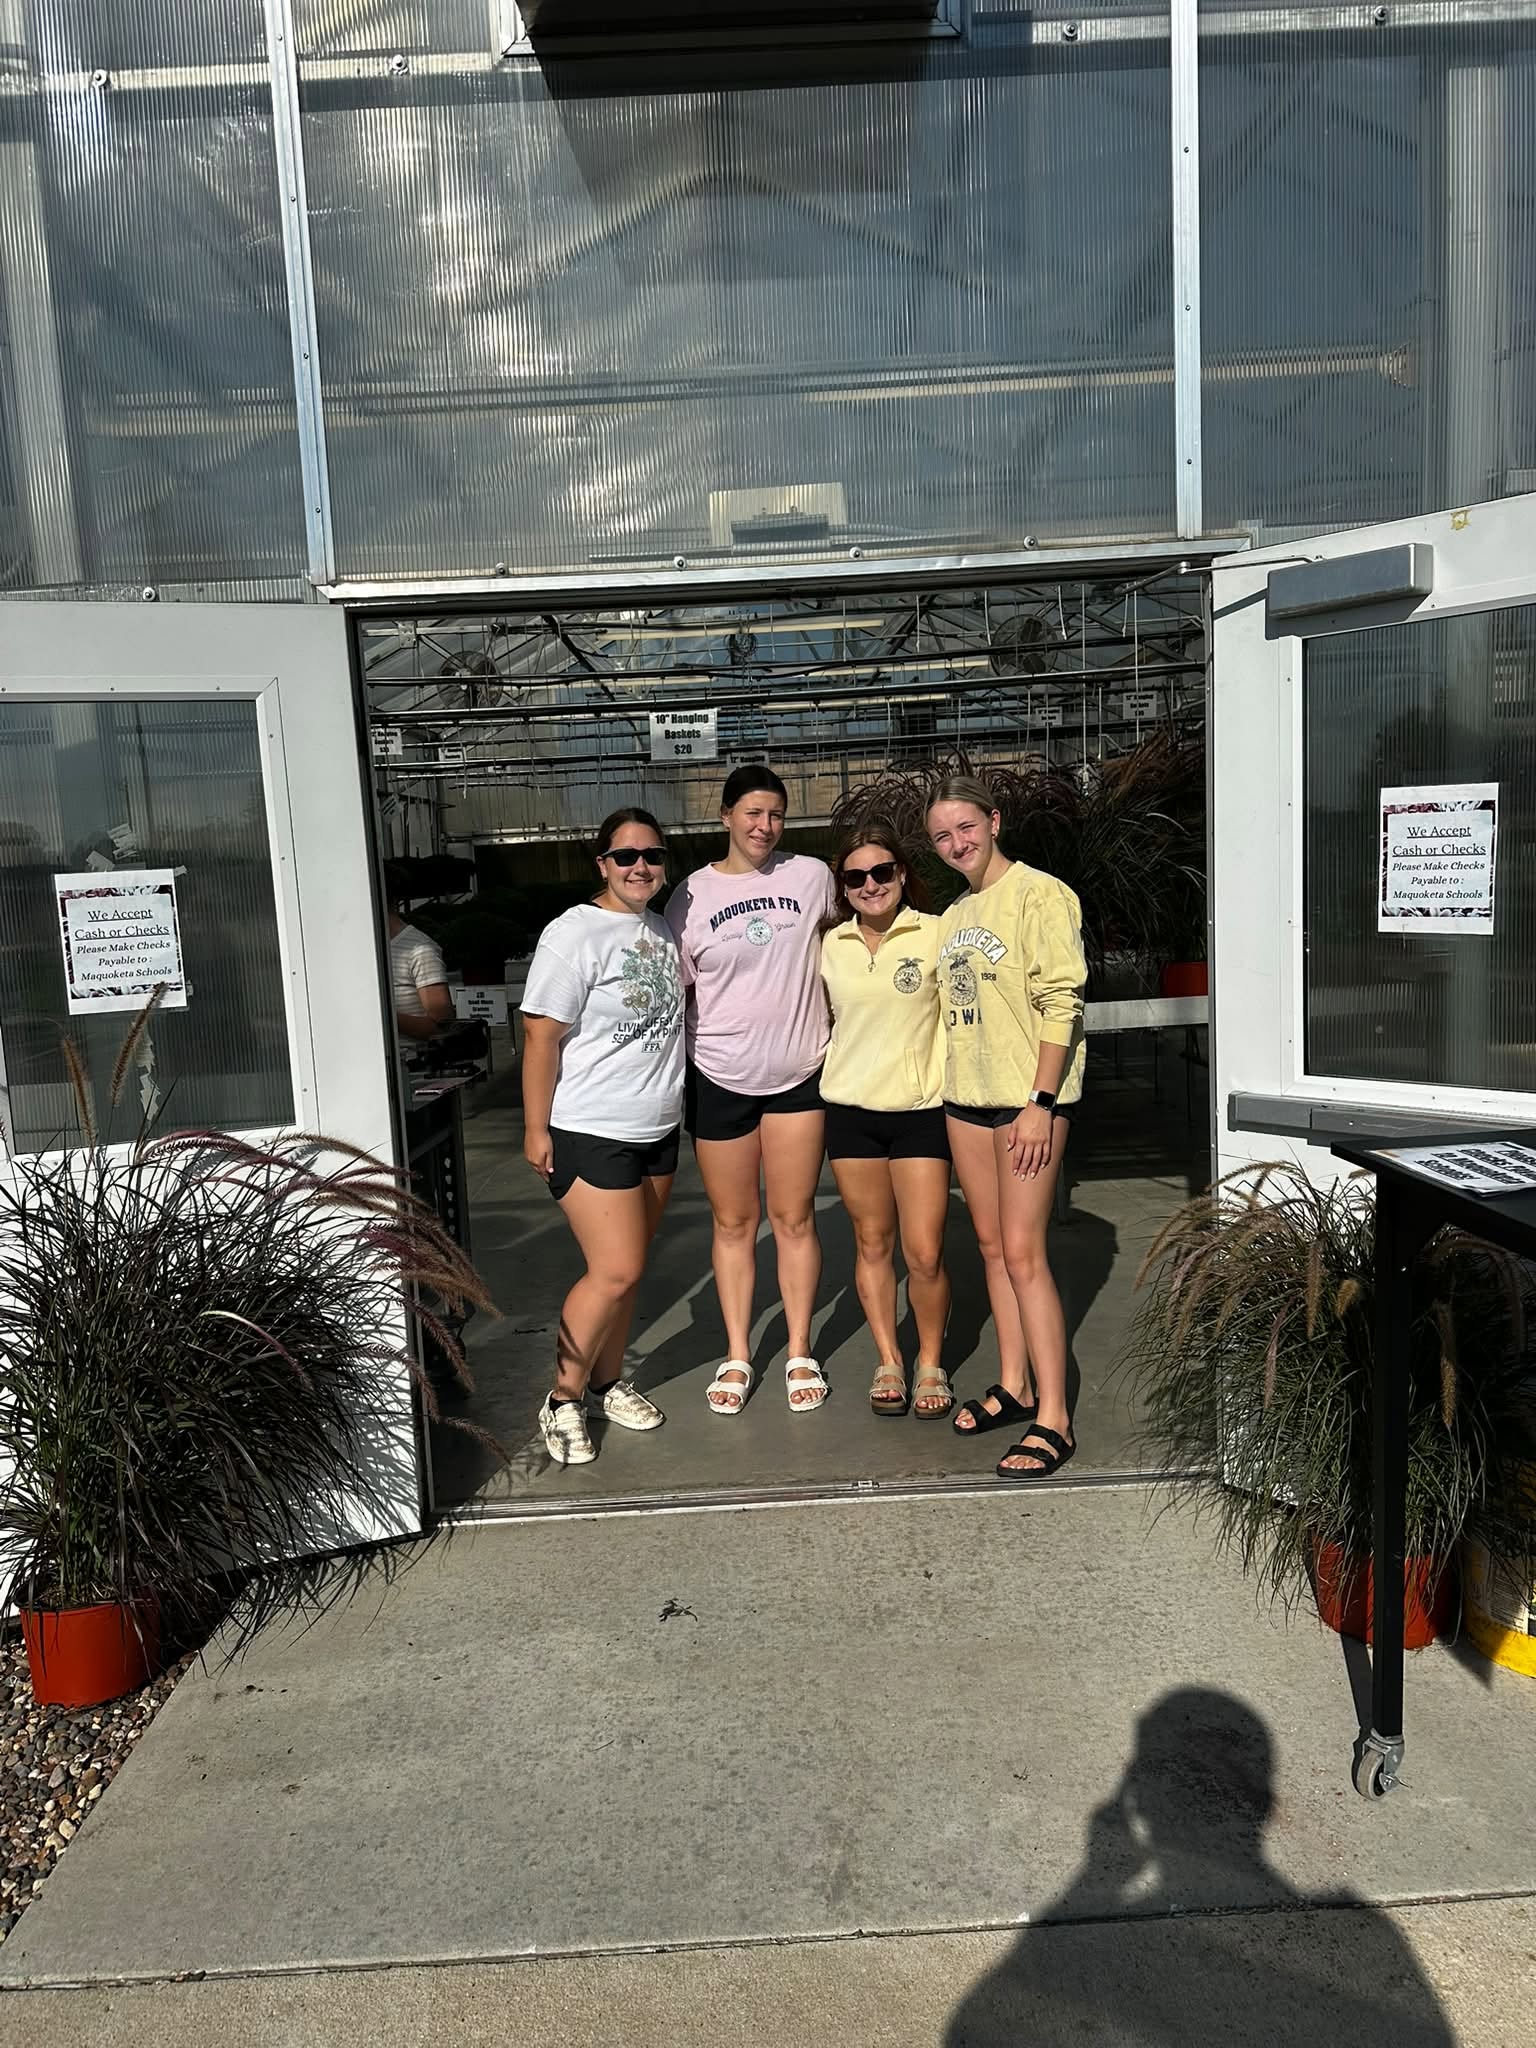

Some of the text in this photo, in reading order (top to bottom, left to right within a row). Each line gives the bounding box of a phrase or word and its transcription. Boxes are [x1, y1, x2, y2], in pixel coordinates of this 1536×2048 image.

[671, 713, 709, 724] Hanging
[664, 729, 701, 739] Baskets
[674, 744, 692, 755] $20
[1407, 826, 1472, 837] We Accept
[1392, 844, 1486, 855] Cash or Checks
[1392, 861, 1485, 871] Please Make Checks
[1411, 876, 1447, 886] Payable
[1393, 890, 1483, 900] Maquoketa Schools
[88, 909, 153, 921] We Accept
[709, 896, 801, 933] MAQUOKETA FFA
[75, 928, 105, 939] Cash
[126, 925, 170, 936] Checks
[77, 941, 171, 954] Please Make Checks
[938, 926, 1008, 967] AQUOKETA
[98, 956, 135, 967] Payable
[81, 967, 172, 981] Maquoketa Schools
[981, 972, 997, 981] 1928
[950, 1008, 982, 1026] OWA
[633, 1029, 647, 1039] OF
[644, 1043, 661, 1052] FFA
